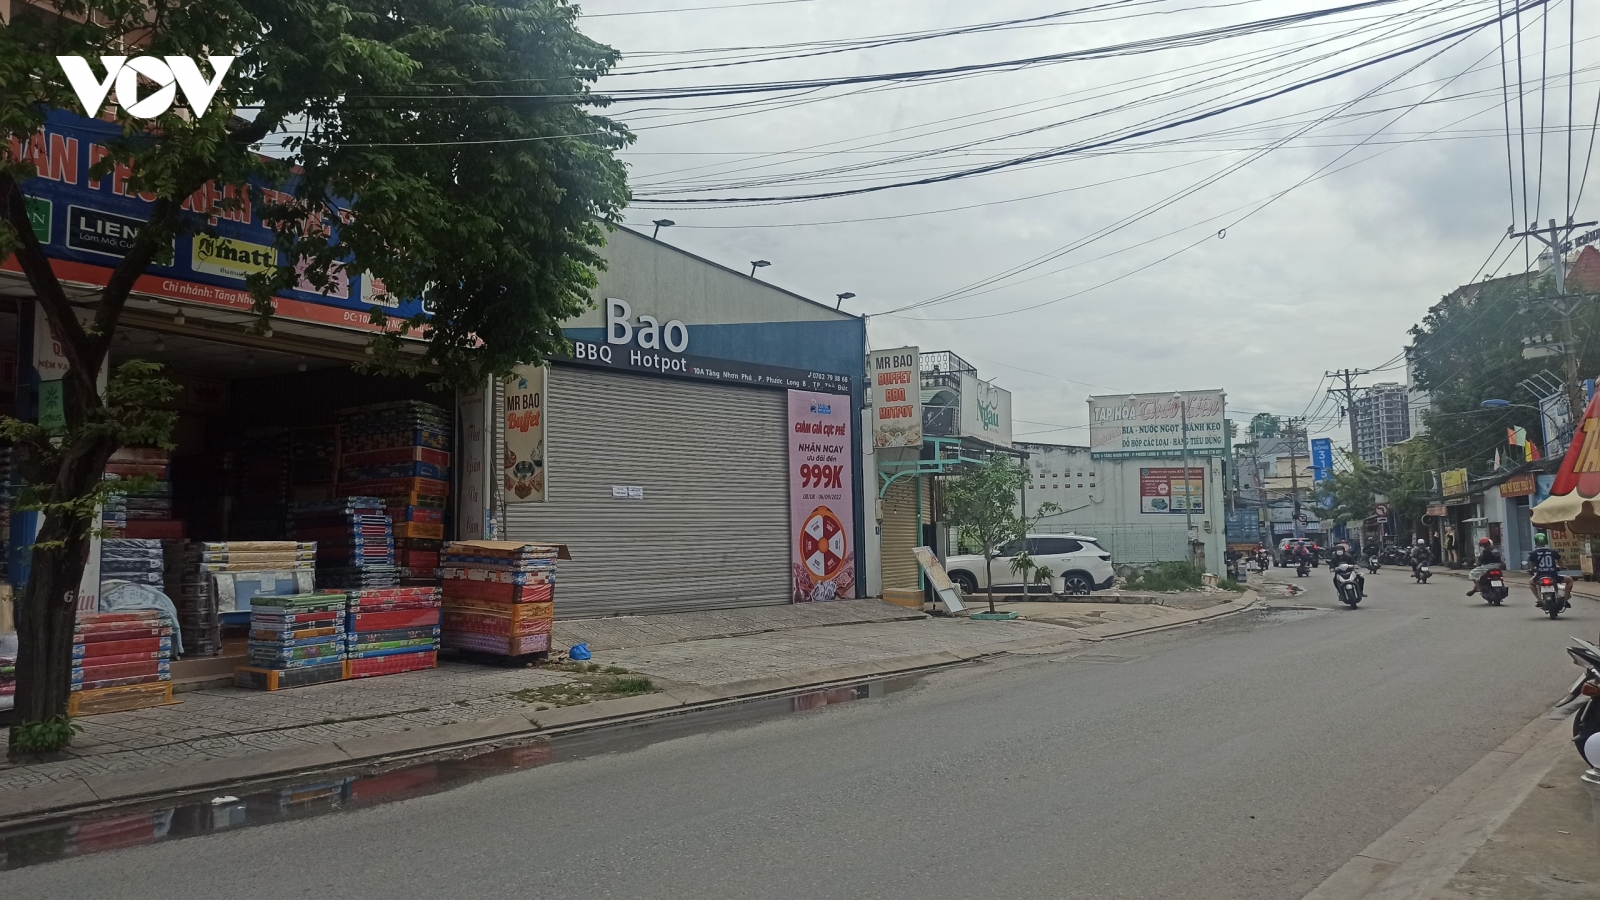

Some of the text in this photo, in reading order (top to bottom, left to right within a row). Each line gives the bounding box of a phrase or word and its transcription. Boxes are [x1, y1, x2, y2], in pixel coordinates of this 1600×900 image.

[162, 280, 178, 292] Chi
[179, 285, 213, 298] nhánh:
[214, 289, 236, 304] Tăng
[605, 297, 689, 353] Bao
[575, 341, 687, 373] BBQ Hotpot
[876, 354, 913, 370] MR BAO
[878, 371, 912, 386] BUFFET
[507, 392, 540, 412] MR BAO
[885, 388, 906, 402] BBQ
[507, 410, 541, 433] Buffet
[879, 405, 914, 420] HOTPOT
[1094, 405, 1114, 426] TẠP
[1114, 401, 1137, 421] HÓA
[1122, 426, 1134, 434] BIA
[1160, 424, 1180, 435] NGỌT
[1185, 421, 1205, 432] BÁNH
[1206, 422, 1221, 433] KẸO
[798, 441, 844, 454] NHẬN NGAY
[800, 463, 844, 489] 999K
[63, 590, 74, 603] 6
